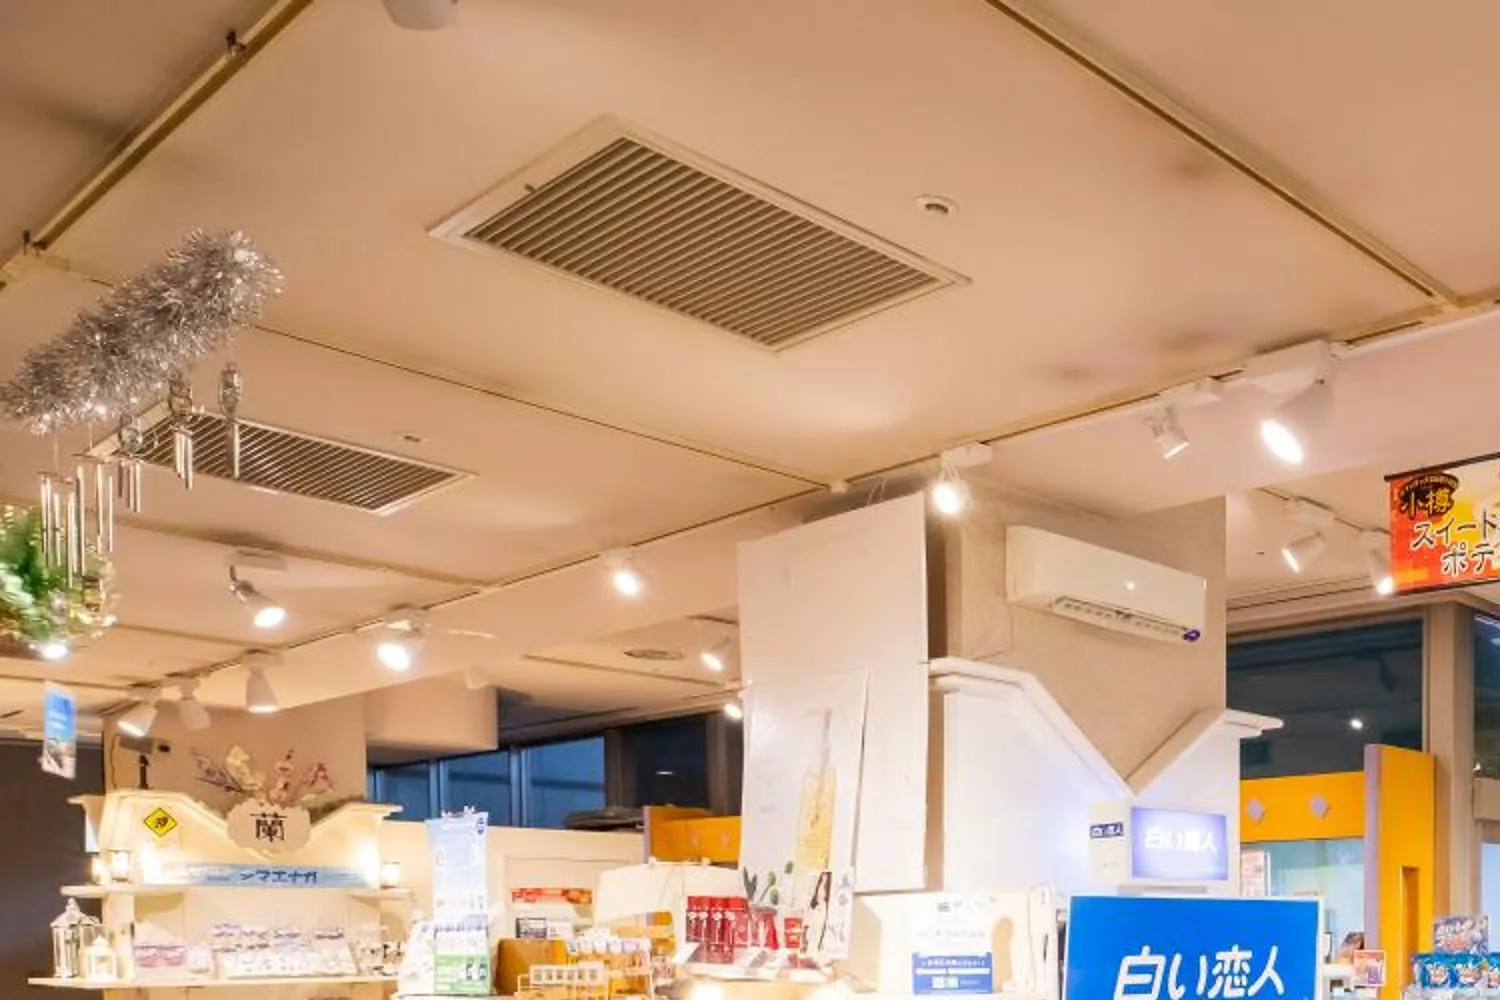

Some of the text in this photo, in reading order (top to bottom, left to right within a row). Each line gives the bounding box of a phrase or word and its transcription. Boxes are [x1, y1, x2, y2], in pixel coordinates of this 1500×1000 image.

[1402, 487, 1451, 518] 小樽
[1412, 509, 1498, 548] スイート
